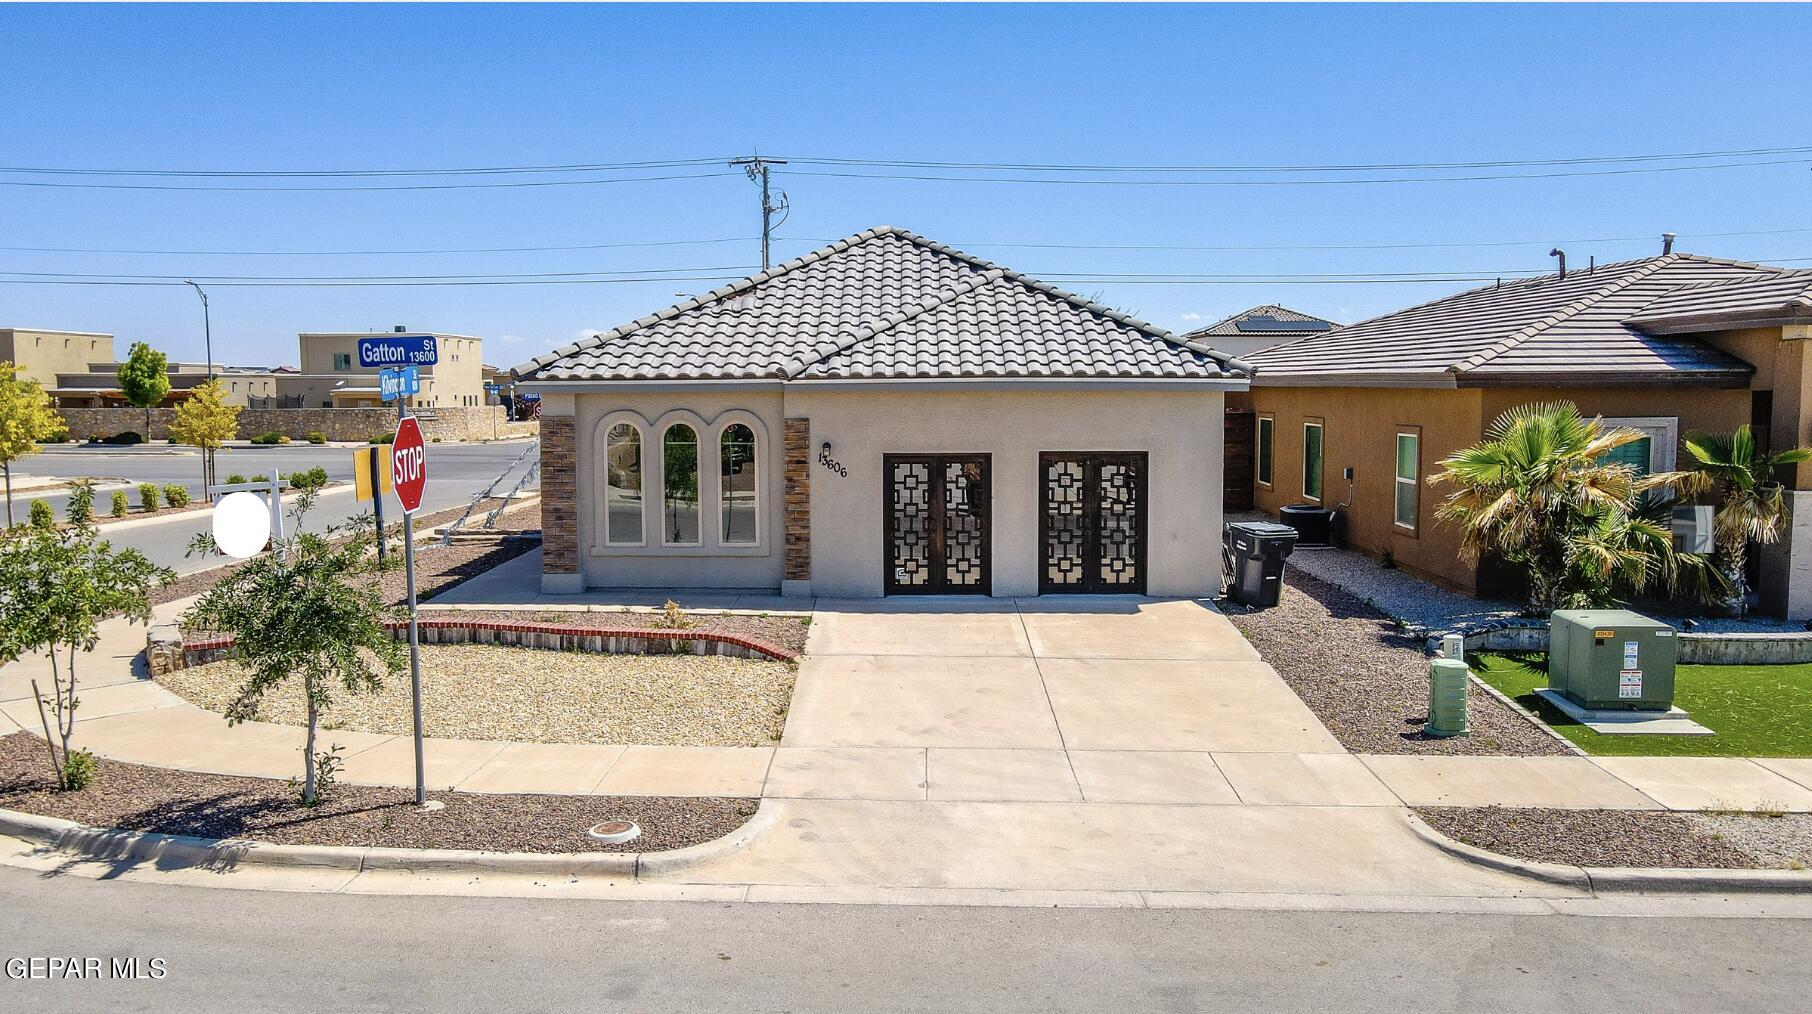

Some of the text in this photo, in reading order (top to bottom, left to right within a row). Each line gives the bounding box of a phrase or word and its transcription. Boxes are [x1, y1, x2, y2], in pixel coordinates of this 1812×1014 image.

[362, 339, 434, 362] Gatton St
[409, 350, 435, 362] 13600
[395, 445, 423, 485] STOP
[818, 452, 847, 478] 13606
